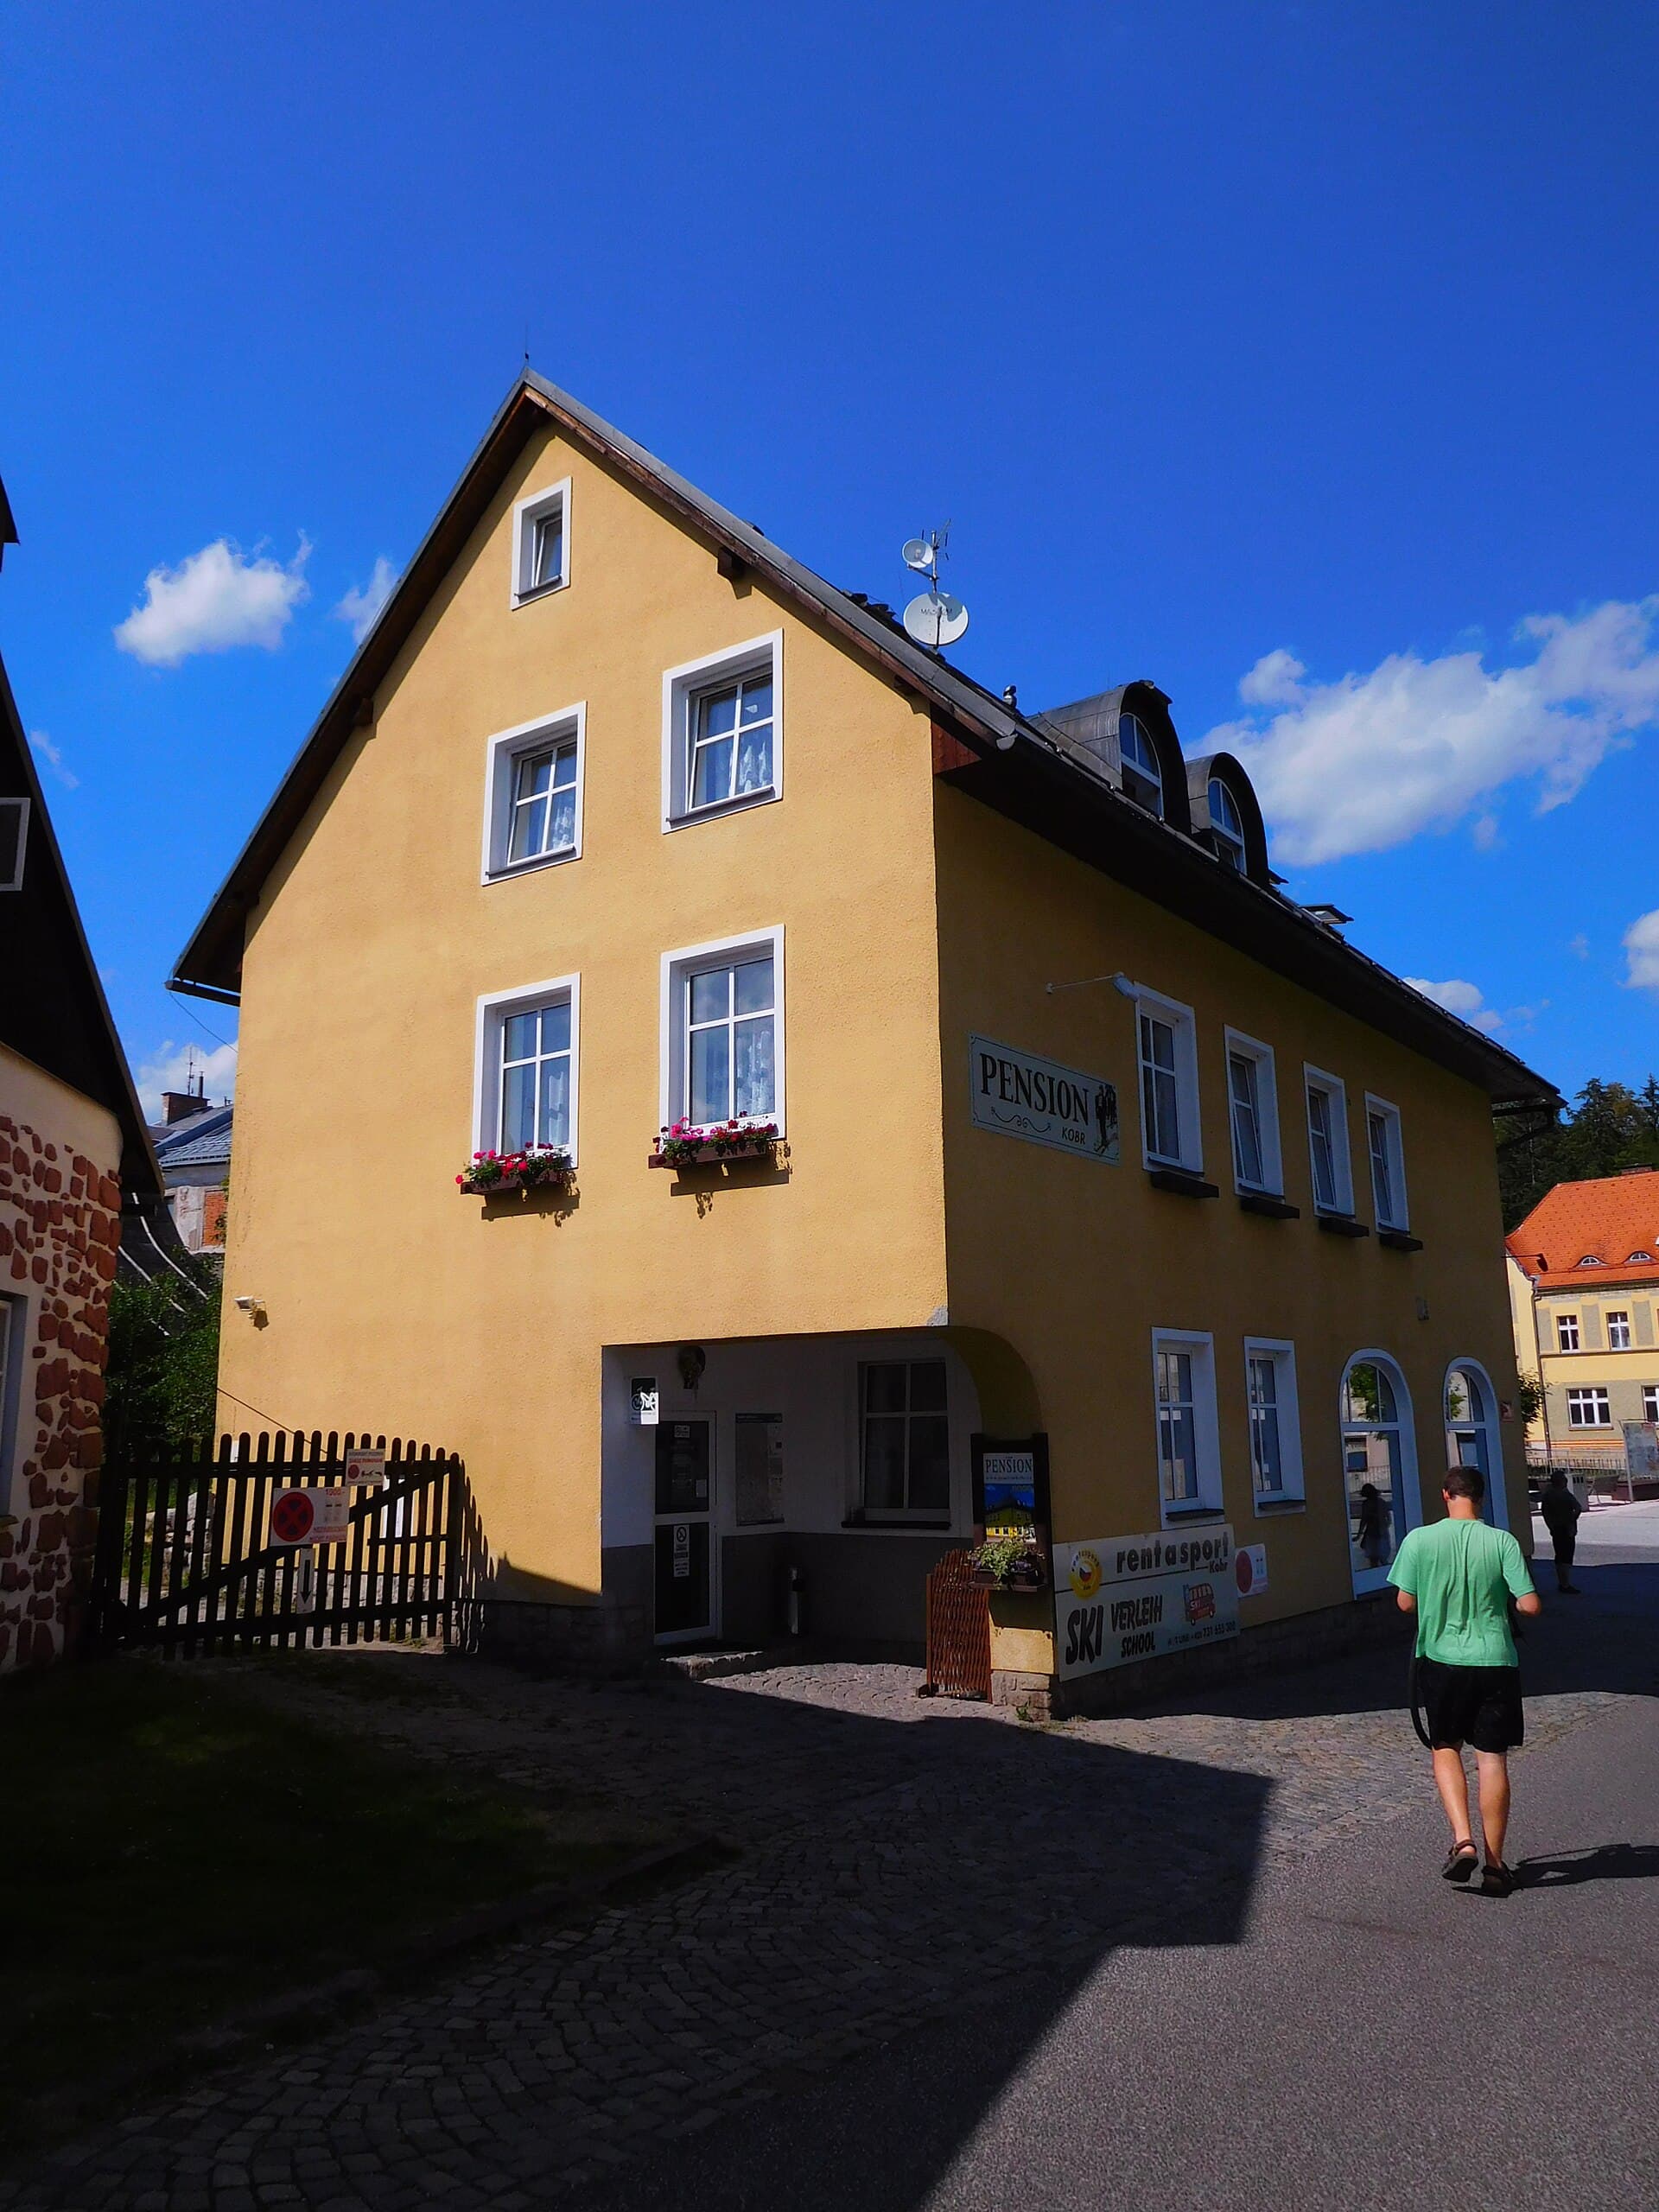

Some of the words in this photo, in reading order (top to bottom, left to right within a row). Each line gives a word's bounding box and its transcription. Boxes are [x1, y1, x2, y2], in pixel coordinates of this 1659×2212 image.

[980, 1052, 1090, 1126] PENSION
[1062, 1126, 1086, 1145] KOBR
[985, 1459, 1033, 1473] PENSION
[1111, 1594, 1163, 1632] VERLEIH
[1065, 1605, 1104, 1665] SKI
[1121, 1631, 1156, 1658] SCHOOL
